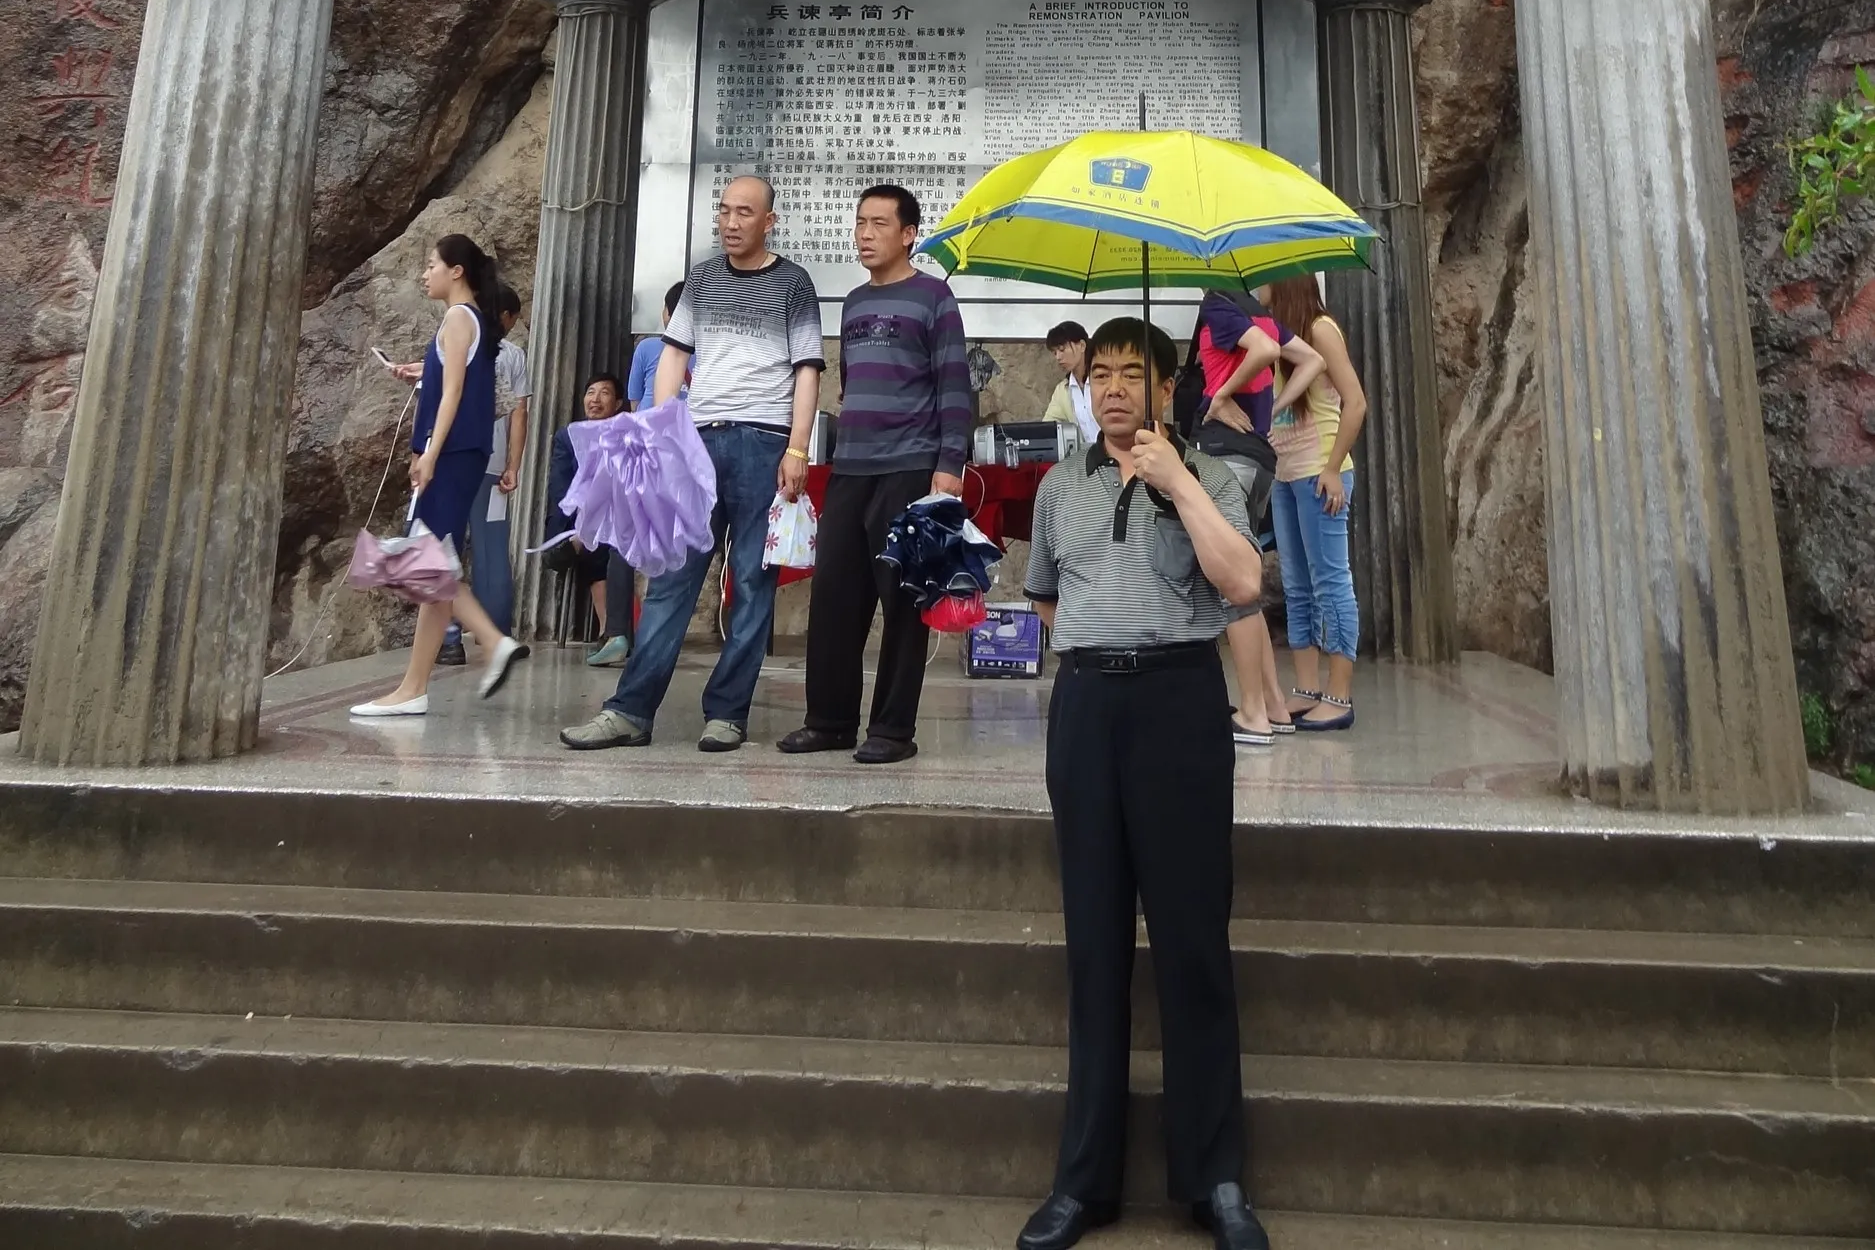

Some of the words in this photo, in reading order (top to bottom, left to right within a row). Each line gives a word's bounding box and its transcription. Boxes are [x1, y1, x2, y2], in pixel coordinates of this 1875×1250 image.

[1045, 2, 1076, 11] BRIEF
[1084, 2, 1165, 11] INTRODUCTION
[767, 4, 915, 21] 兵谏亭简介
[1029, 12, 1123, 20] REMONSTRATION
[1139, 11, 1190, 20] PAVILION
[985, 611, 1001, 619] SON
